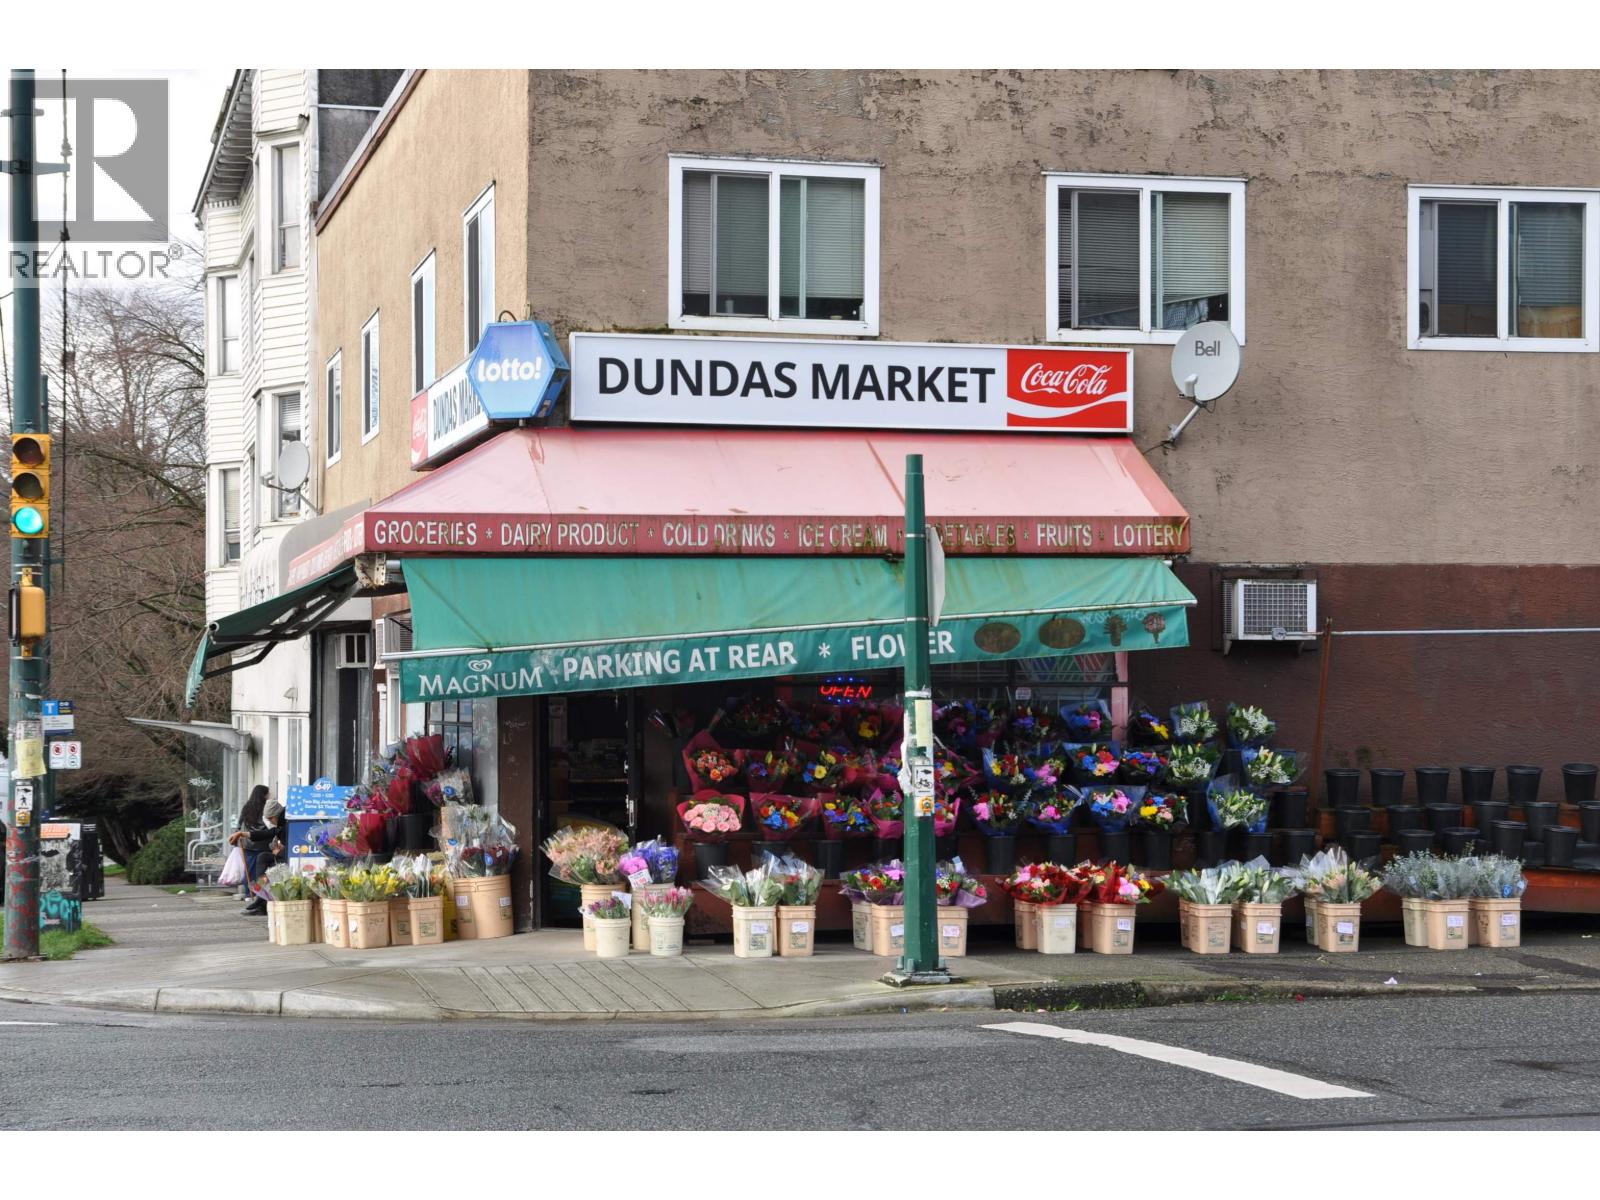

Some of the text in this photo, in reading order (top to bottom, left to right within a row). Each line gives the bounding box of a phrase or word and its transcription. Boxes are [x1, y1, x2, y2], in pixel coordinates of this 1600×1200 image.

[1195, 340, 1221, 357] Bell
[478, 356, 542, 382] lotto!
[599, 357, 996, 403] DUNDAS MARKET
[1021, 362, 1112, 395] Coca-Cola
[433, 384, 458, 441] DUNDAS
[459, 377, 484, 426] MARKE
[374, 520, 477, 546] GROCERIES
[501, 522, 551, 546] DAIRY
[557, 522, 639, 546] PRODUCT
[663, 521, 708, 546] COLD
[798, 523, 824, 547] ICE
[829, 523, 887, 548] CREAM
[1037, 523, 1092, 547] FRUITS
[1114, 523, 1184, 547] LOTTERY
[563, 630, 956, 682] PARKING AT REAR FLOER
[418, 665, 544, 697] MAGNUM
